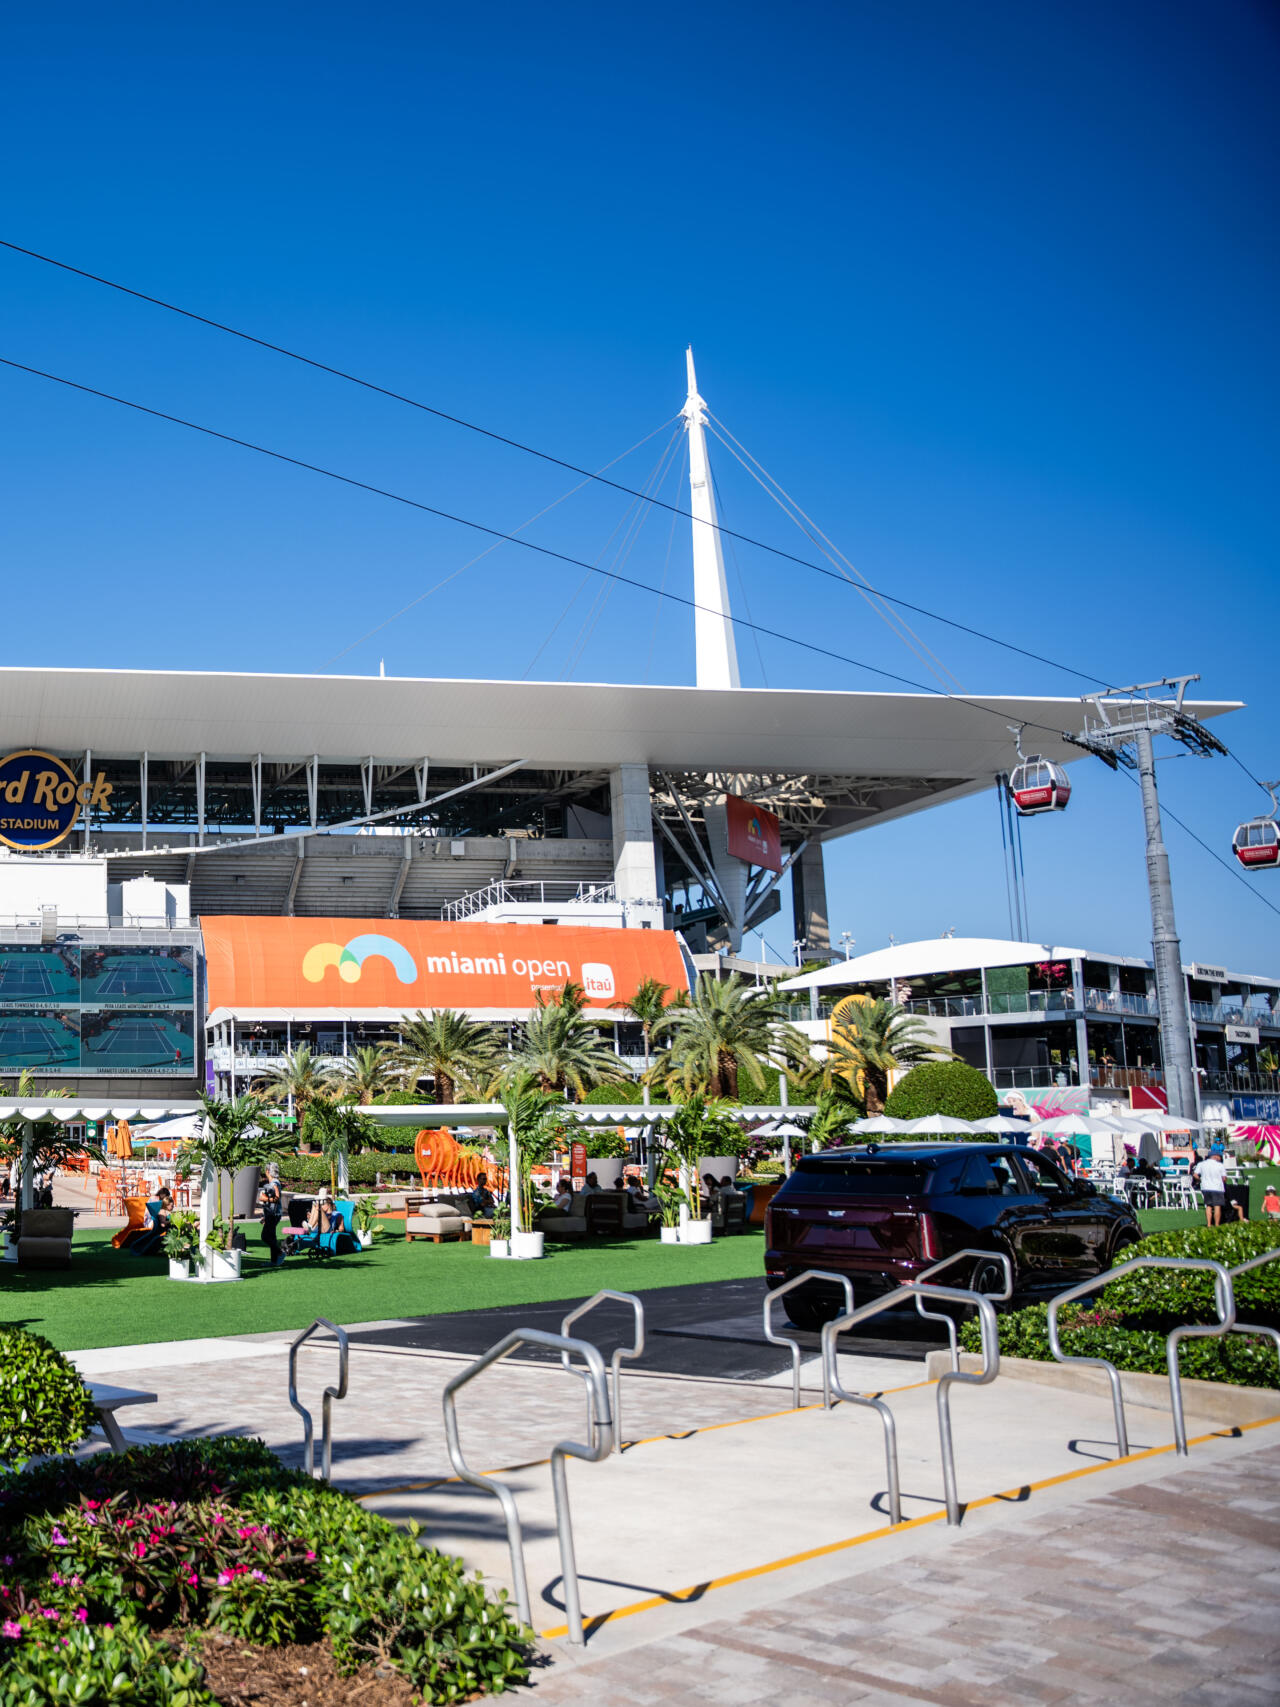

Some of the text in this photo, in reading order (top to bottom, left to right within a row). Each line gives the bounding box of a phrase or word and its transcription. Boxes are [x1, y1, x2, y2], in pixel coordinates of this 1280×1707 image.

[32, 771, 113, 812] Rock
[0, 818, 60, 830] STADIUM
[427, 951, 571, 982] miami open
[586, 977, 612, 992] itaú
